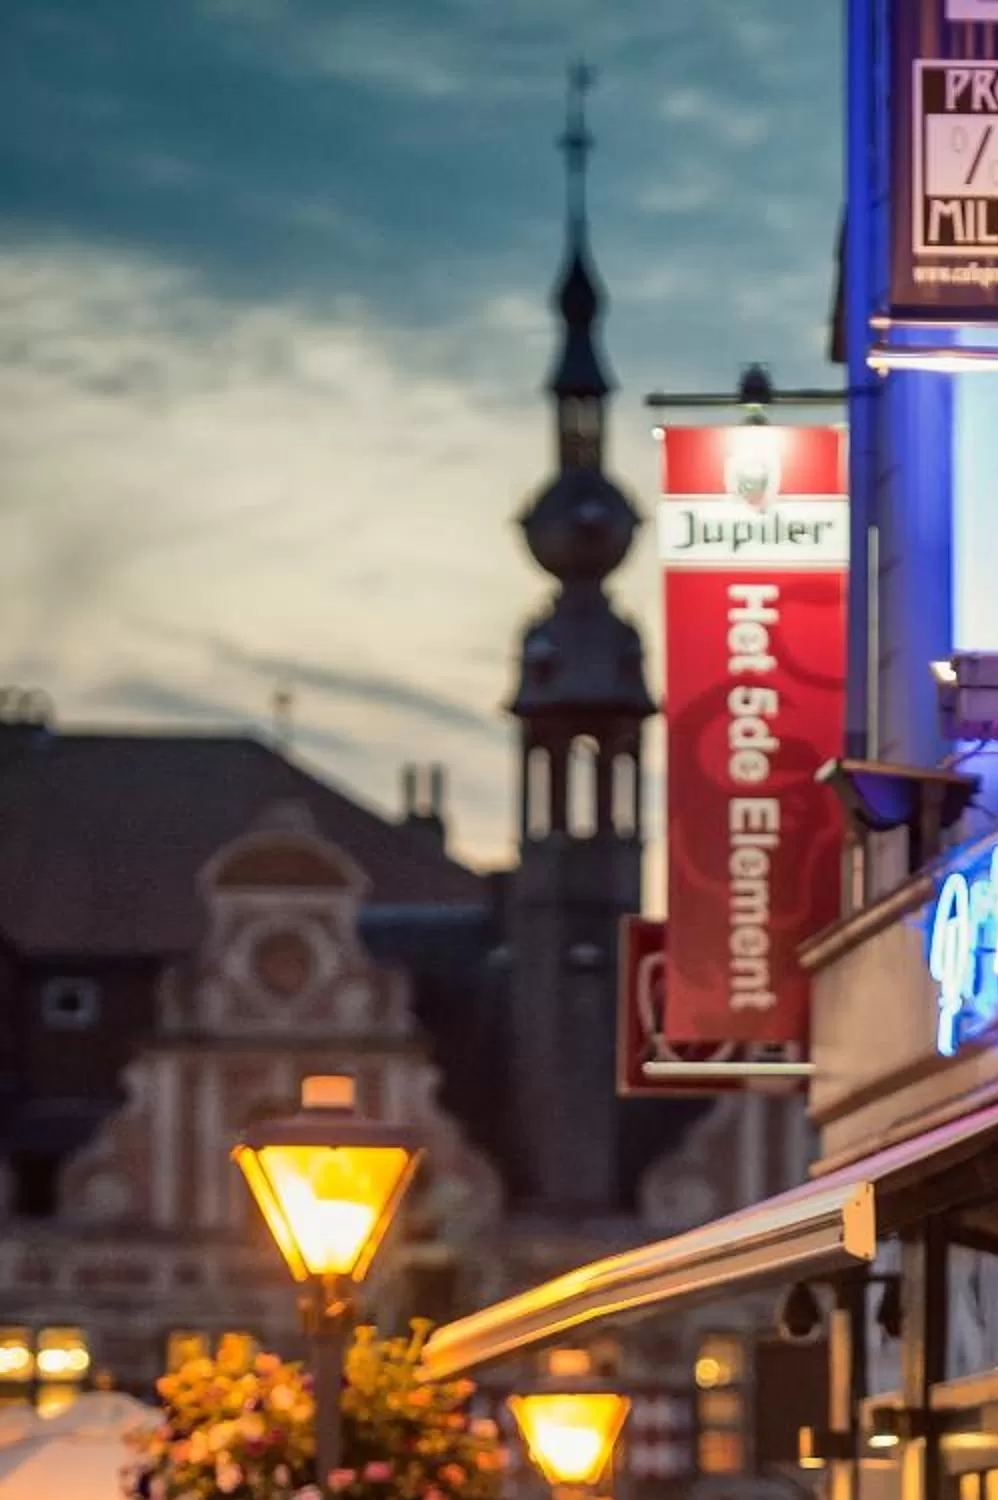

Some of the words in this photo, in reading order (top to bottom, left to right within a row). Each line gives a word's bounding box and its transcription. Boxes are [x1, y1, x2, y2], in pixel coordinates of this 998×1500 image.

[673, 510, 834, 552] Jupiler
[727, 584, 779, 674] Het
[728, 688, 780, 781] 5de
[728, 798, 781, 1010] Element
